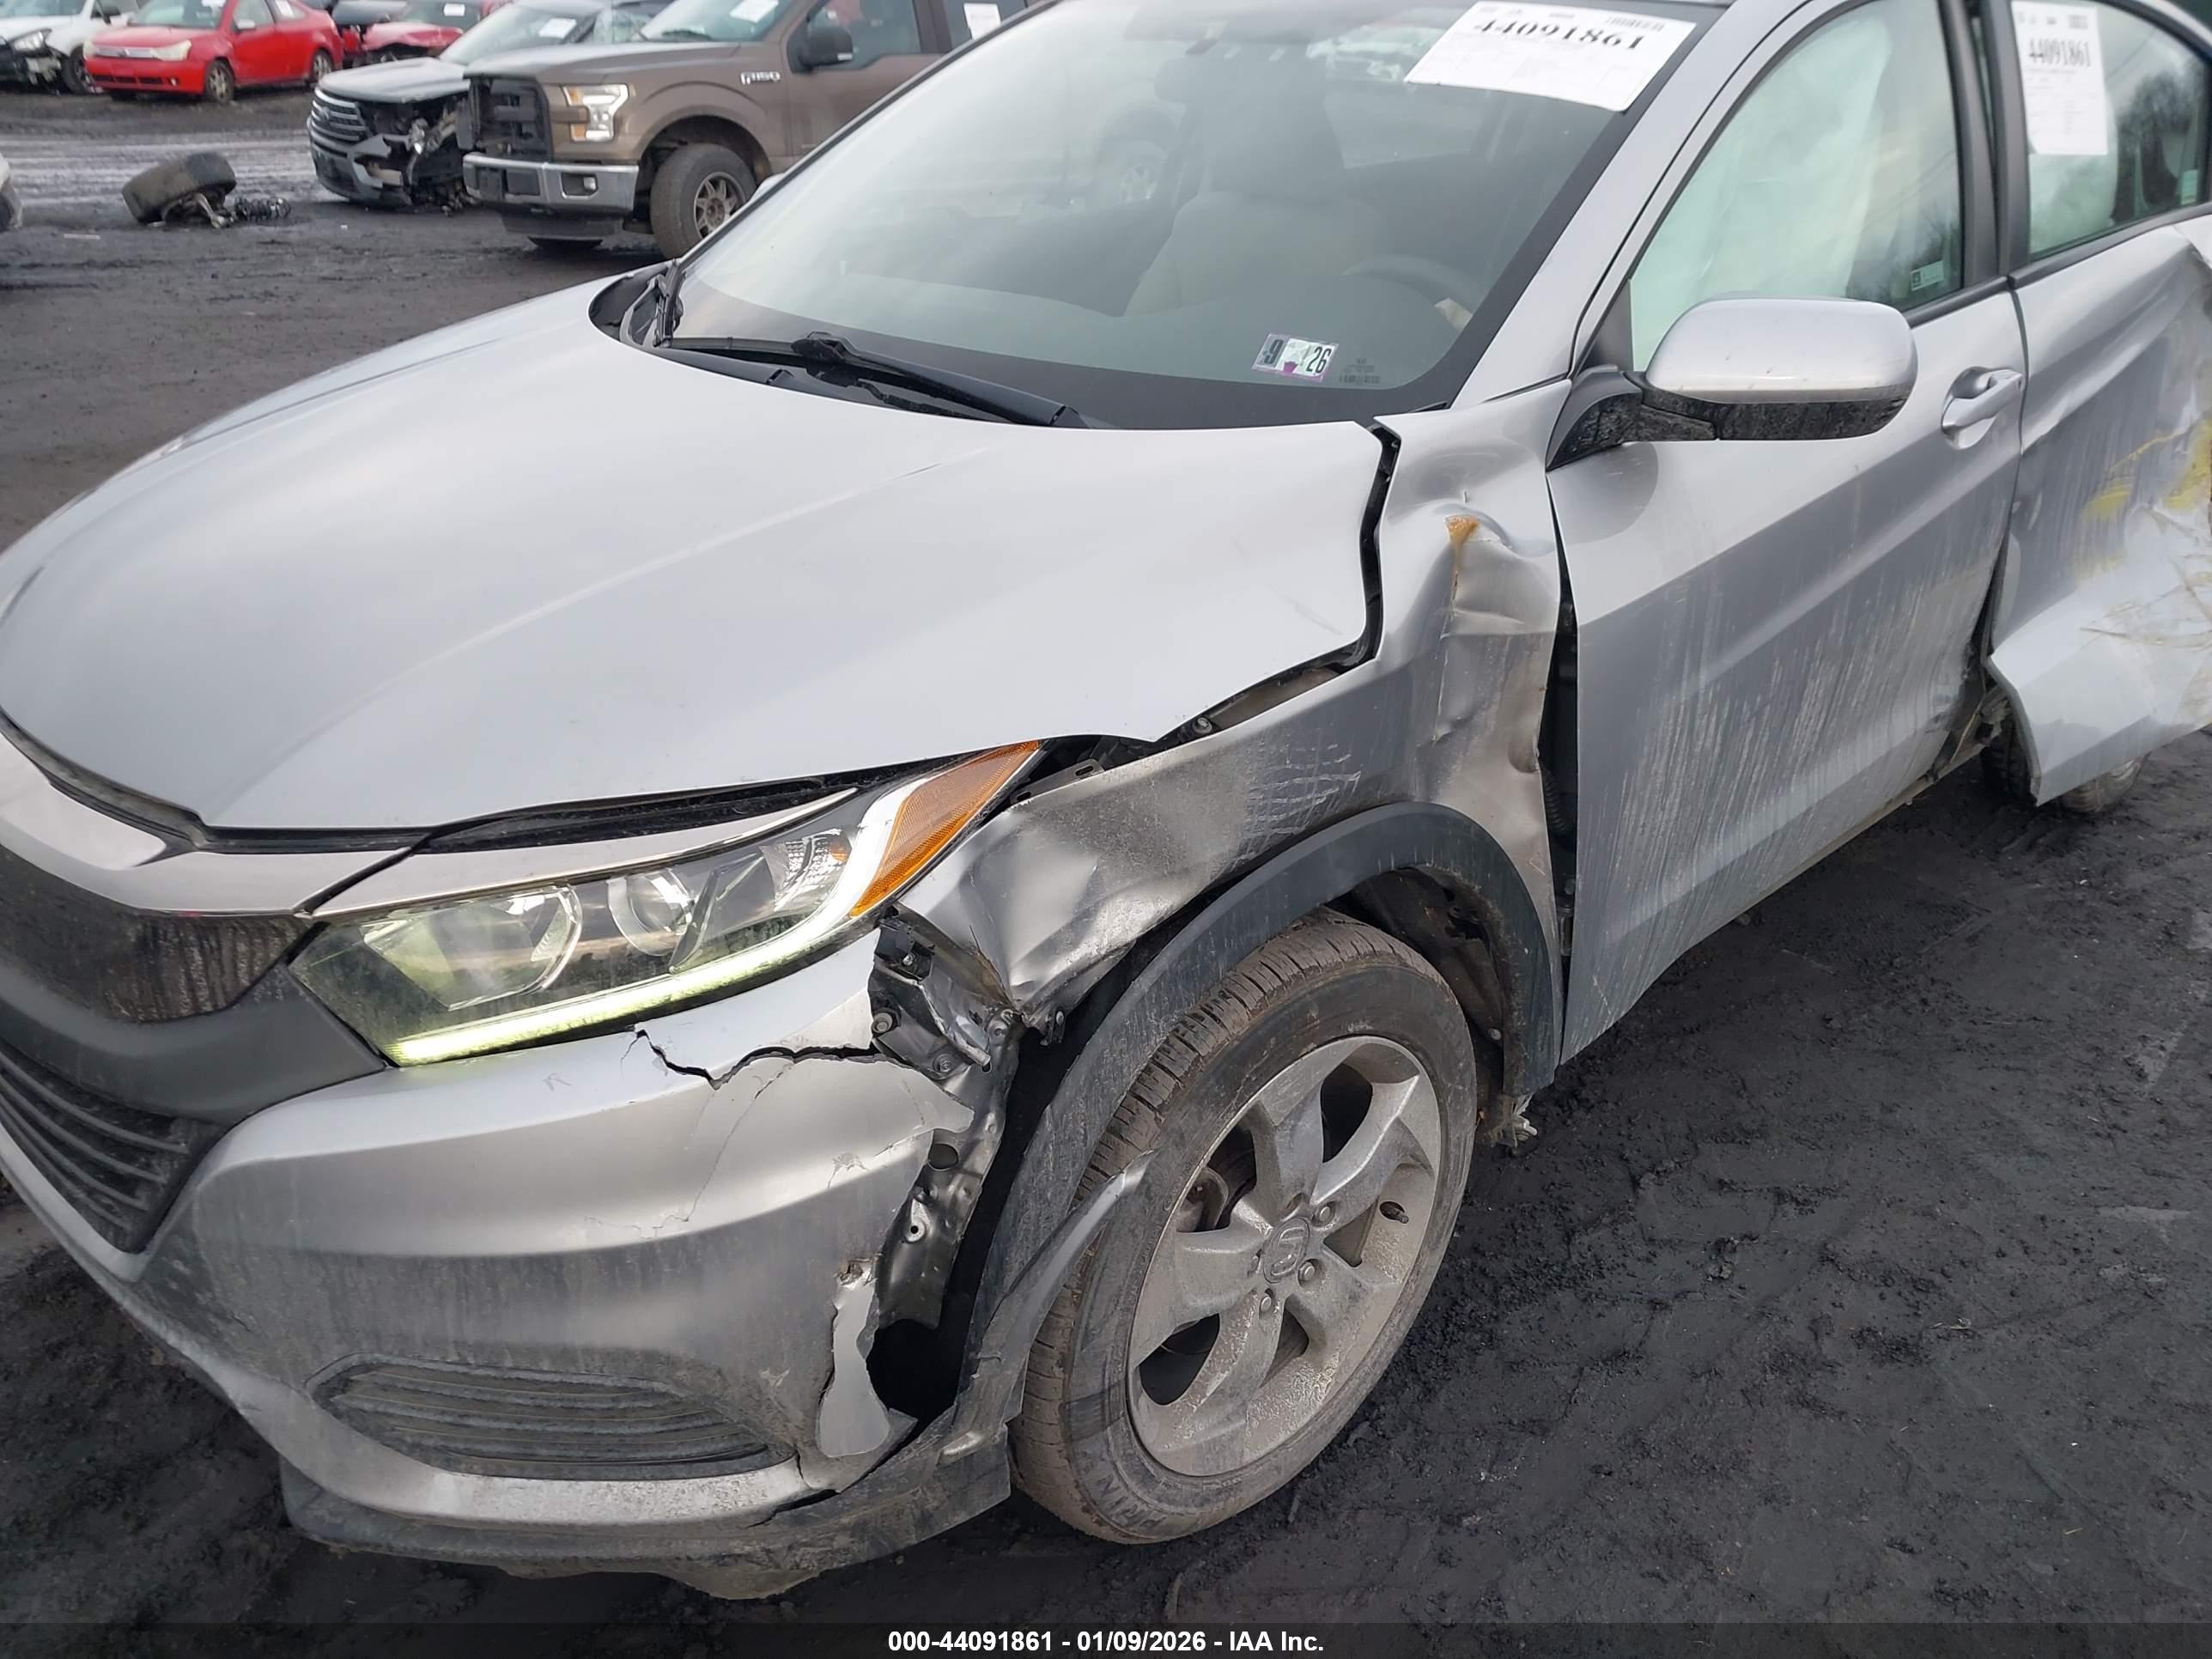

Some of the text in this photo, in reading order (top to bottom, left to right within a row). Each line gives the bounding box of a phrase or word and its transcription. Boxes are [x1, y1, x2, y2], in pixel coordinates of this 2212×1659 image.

[1474, 19, 1645, 50] 44091861
[2029, 39, 2092, 67] 44091861
[1263, 338, 1285, 365] 9
[1305, 345, 1333, 374] 26
